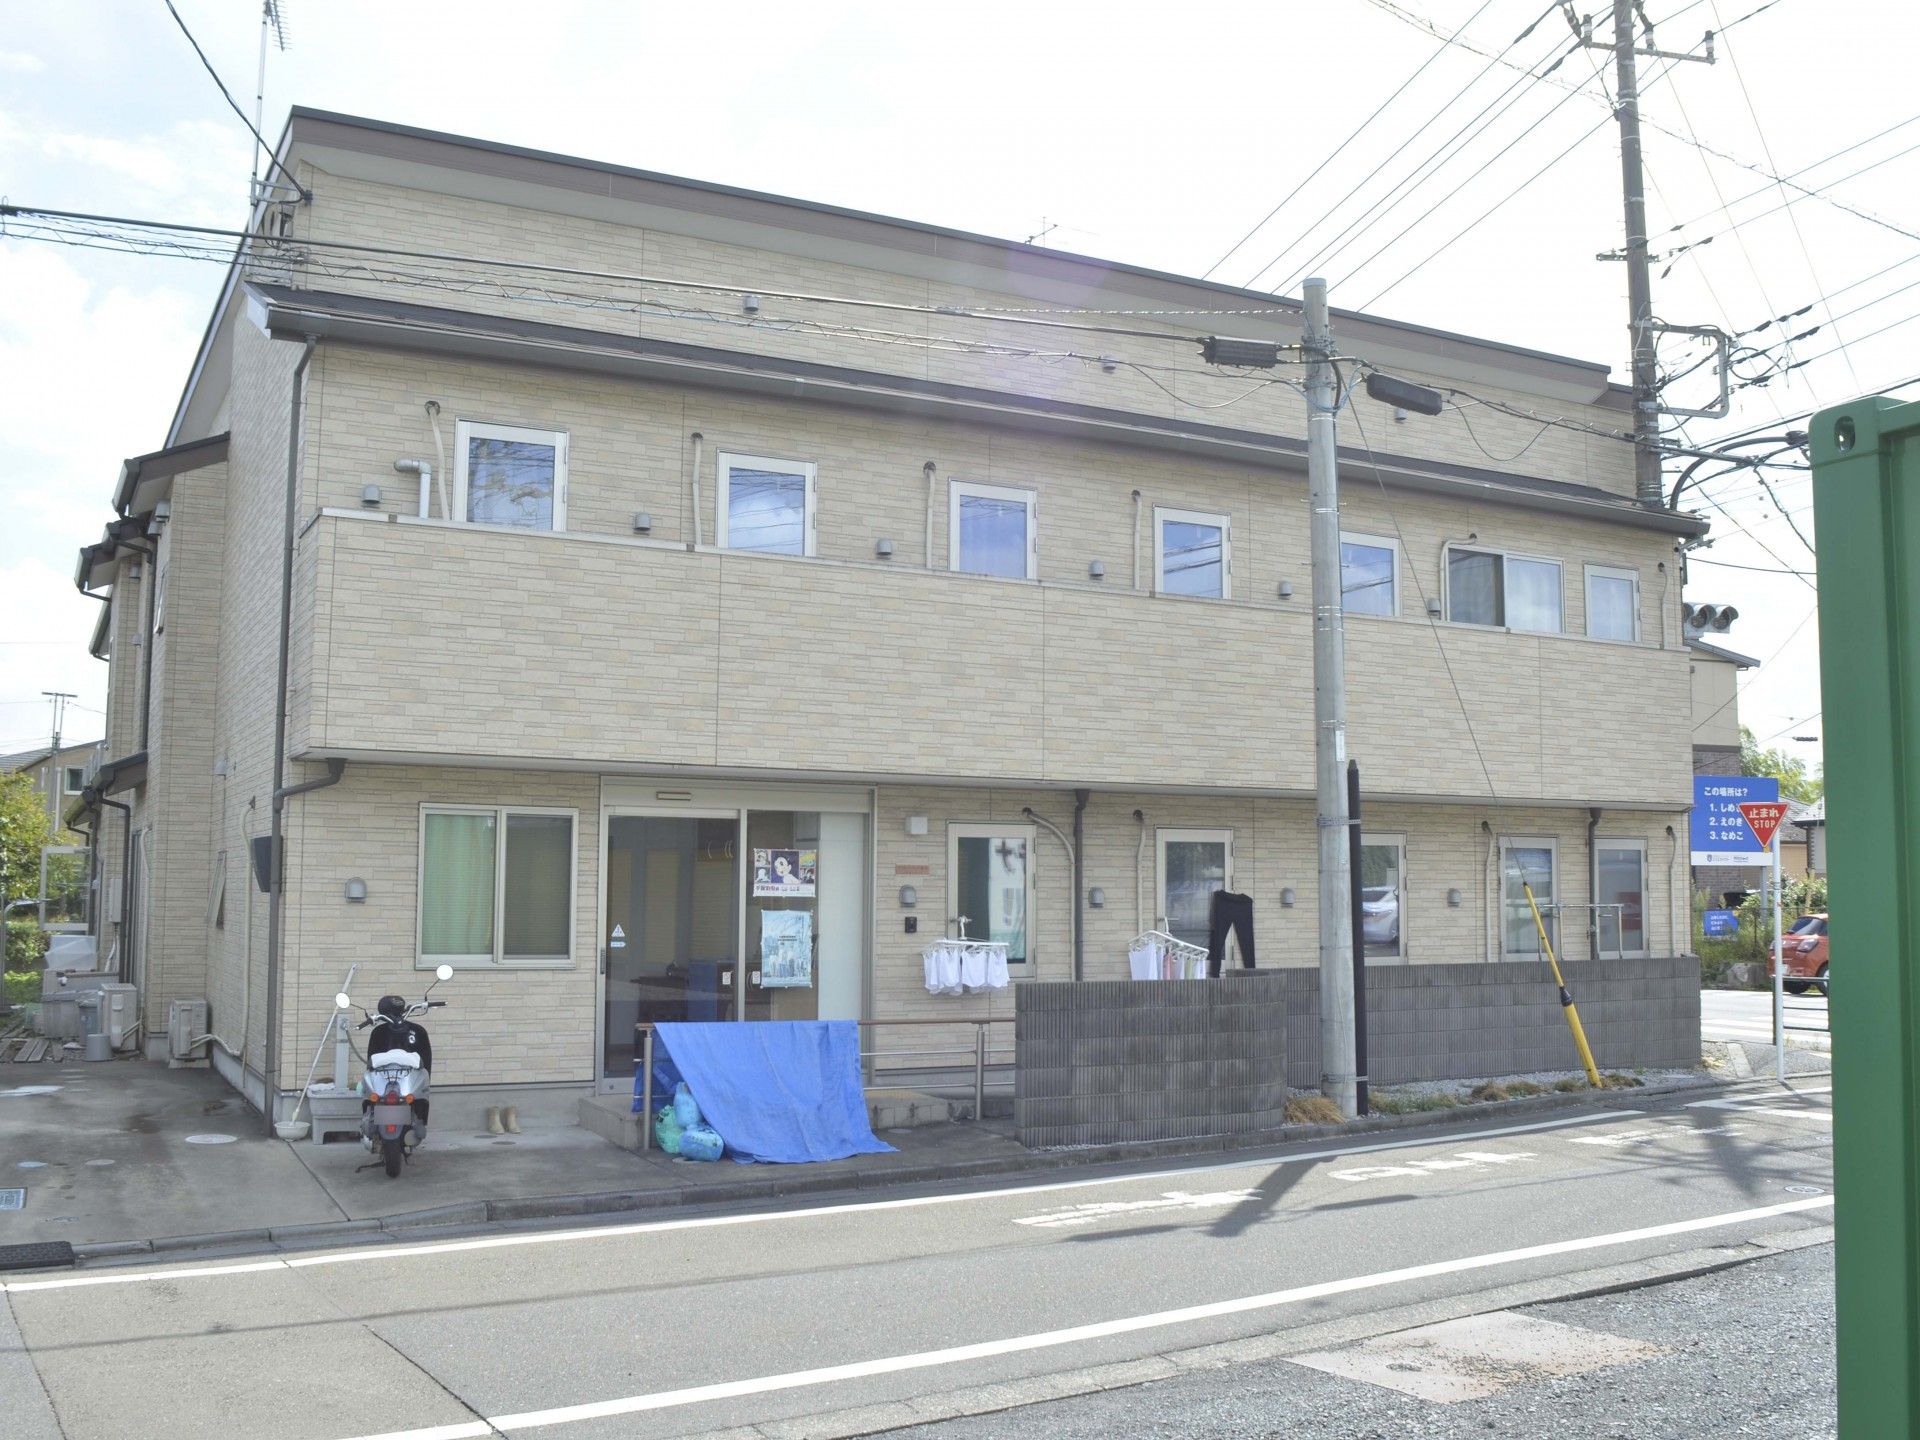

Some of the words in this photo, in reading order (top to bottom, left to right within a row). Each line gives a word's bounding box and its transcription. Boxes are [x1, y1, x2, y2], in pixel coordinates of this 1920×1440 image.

[1704, 787, 1748, 797] この場所は?
[1748, 808, 1779, 819] 止まれ
[1709, 817, 1718, 826] 2.
[1720, 817, 1743, 827] えのき
[1753, 820, 1776, 829] STOP
[1709, 831, 1718, 840] 3.
[1720, 831, 1744, 841] なめこ
